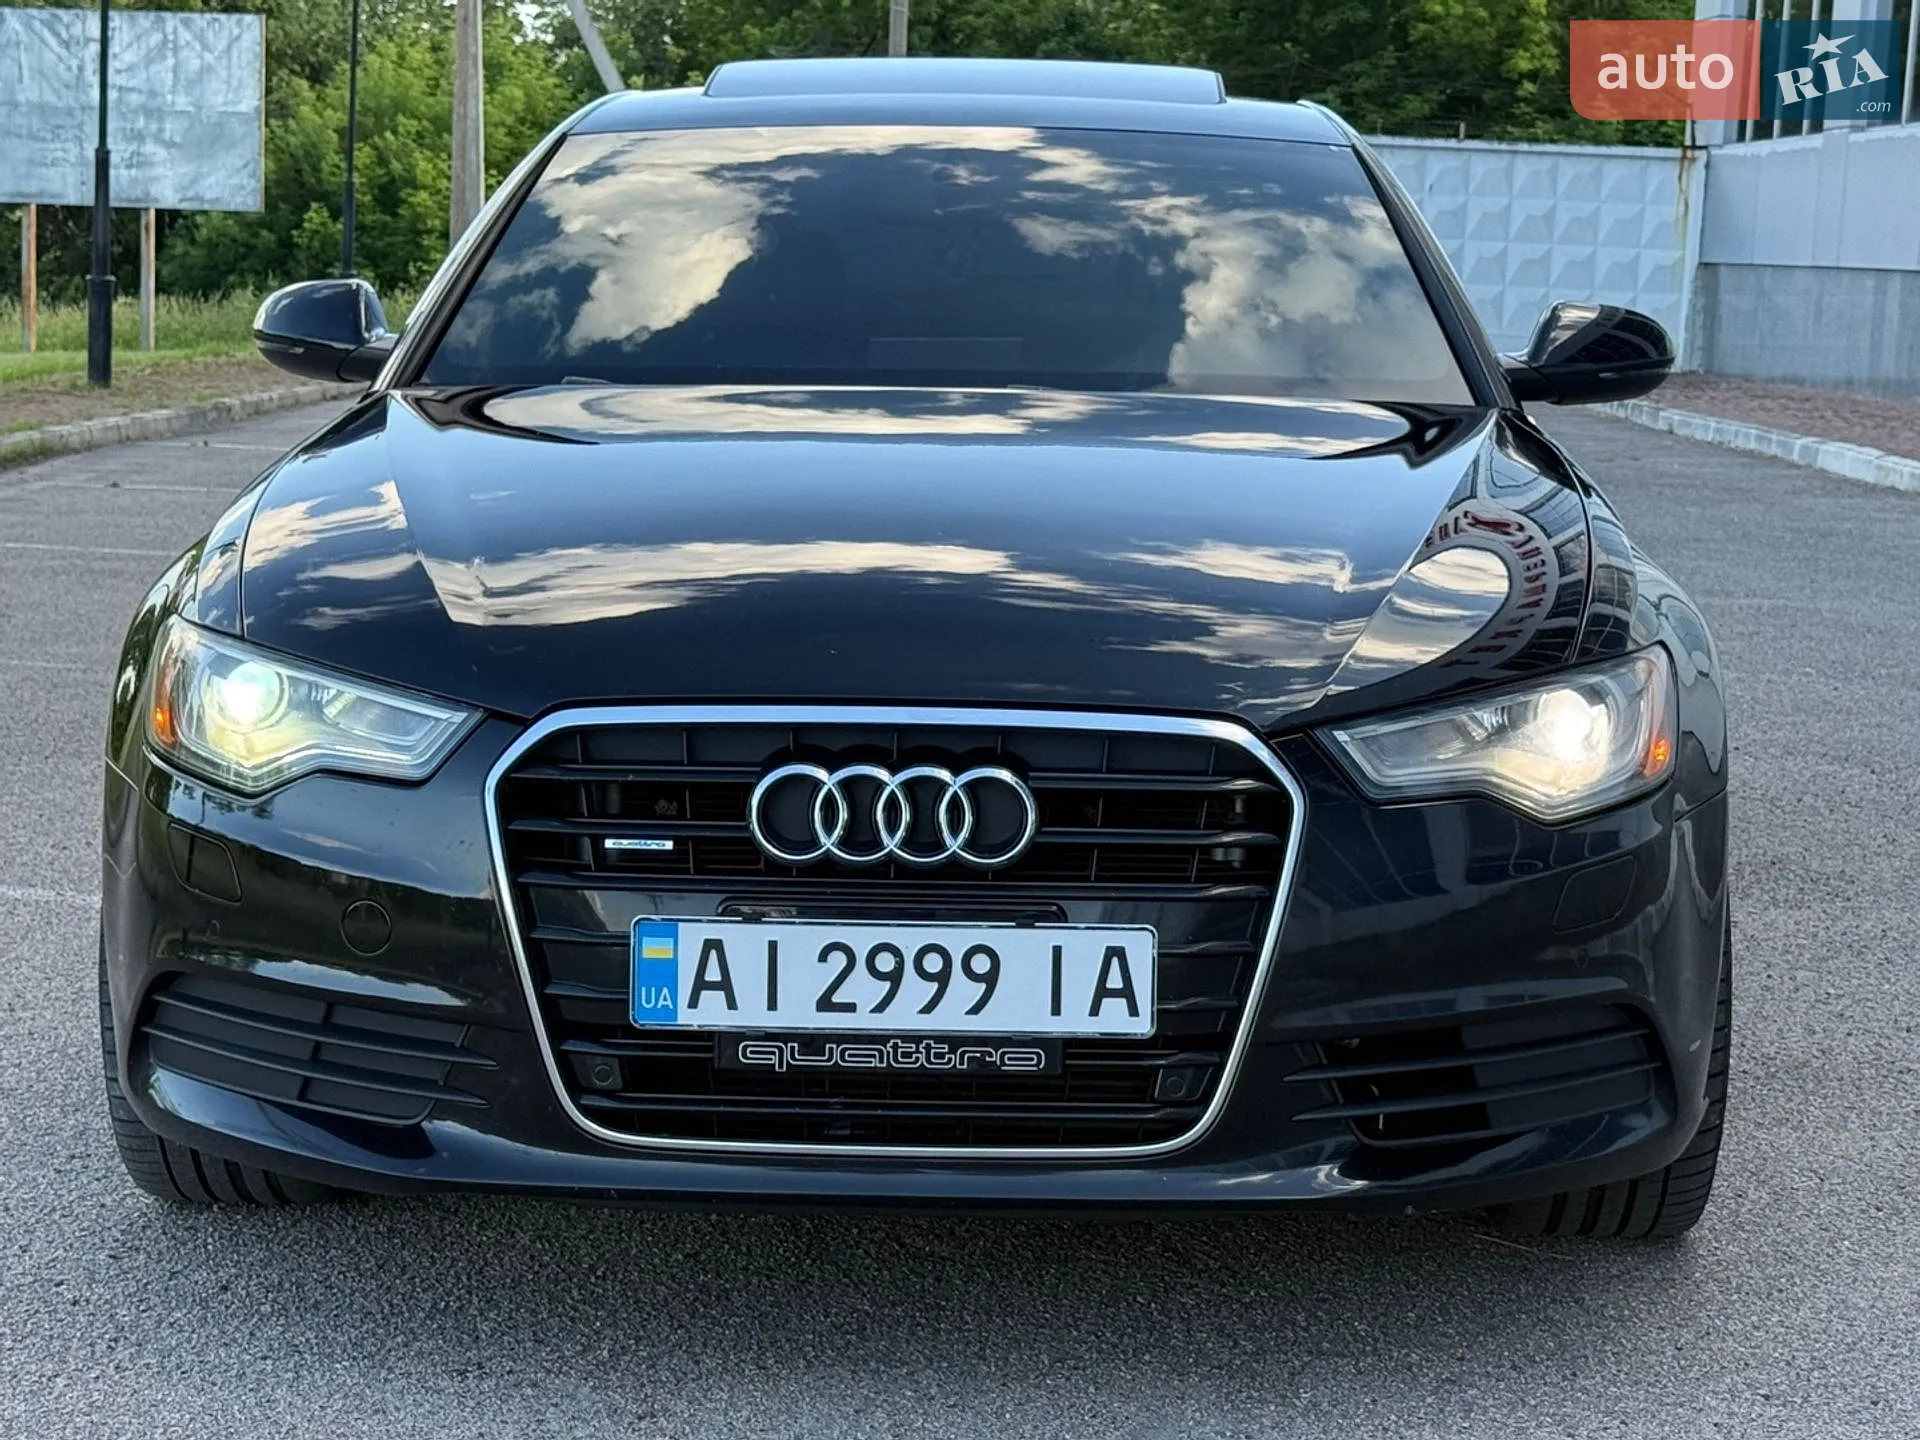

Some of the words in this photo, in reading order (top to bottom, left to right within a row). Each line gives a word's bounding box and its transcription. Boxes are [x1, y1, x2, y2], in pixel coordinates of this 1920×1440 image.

[686, 937, 779, 1011] AI
[814, 940, 1002, 1016] 2999
[1049, 944, 1141, 1018] IA
[640, 986, 674, 1010] UA
[737, 1038, 1046, 1073] quattro
